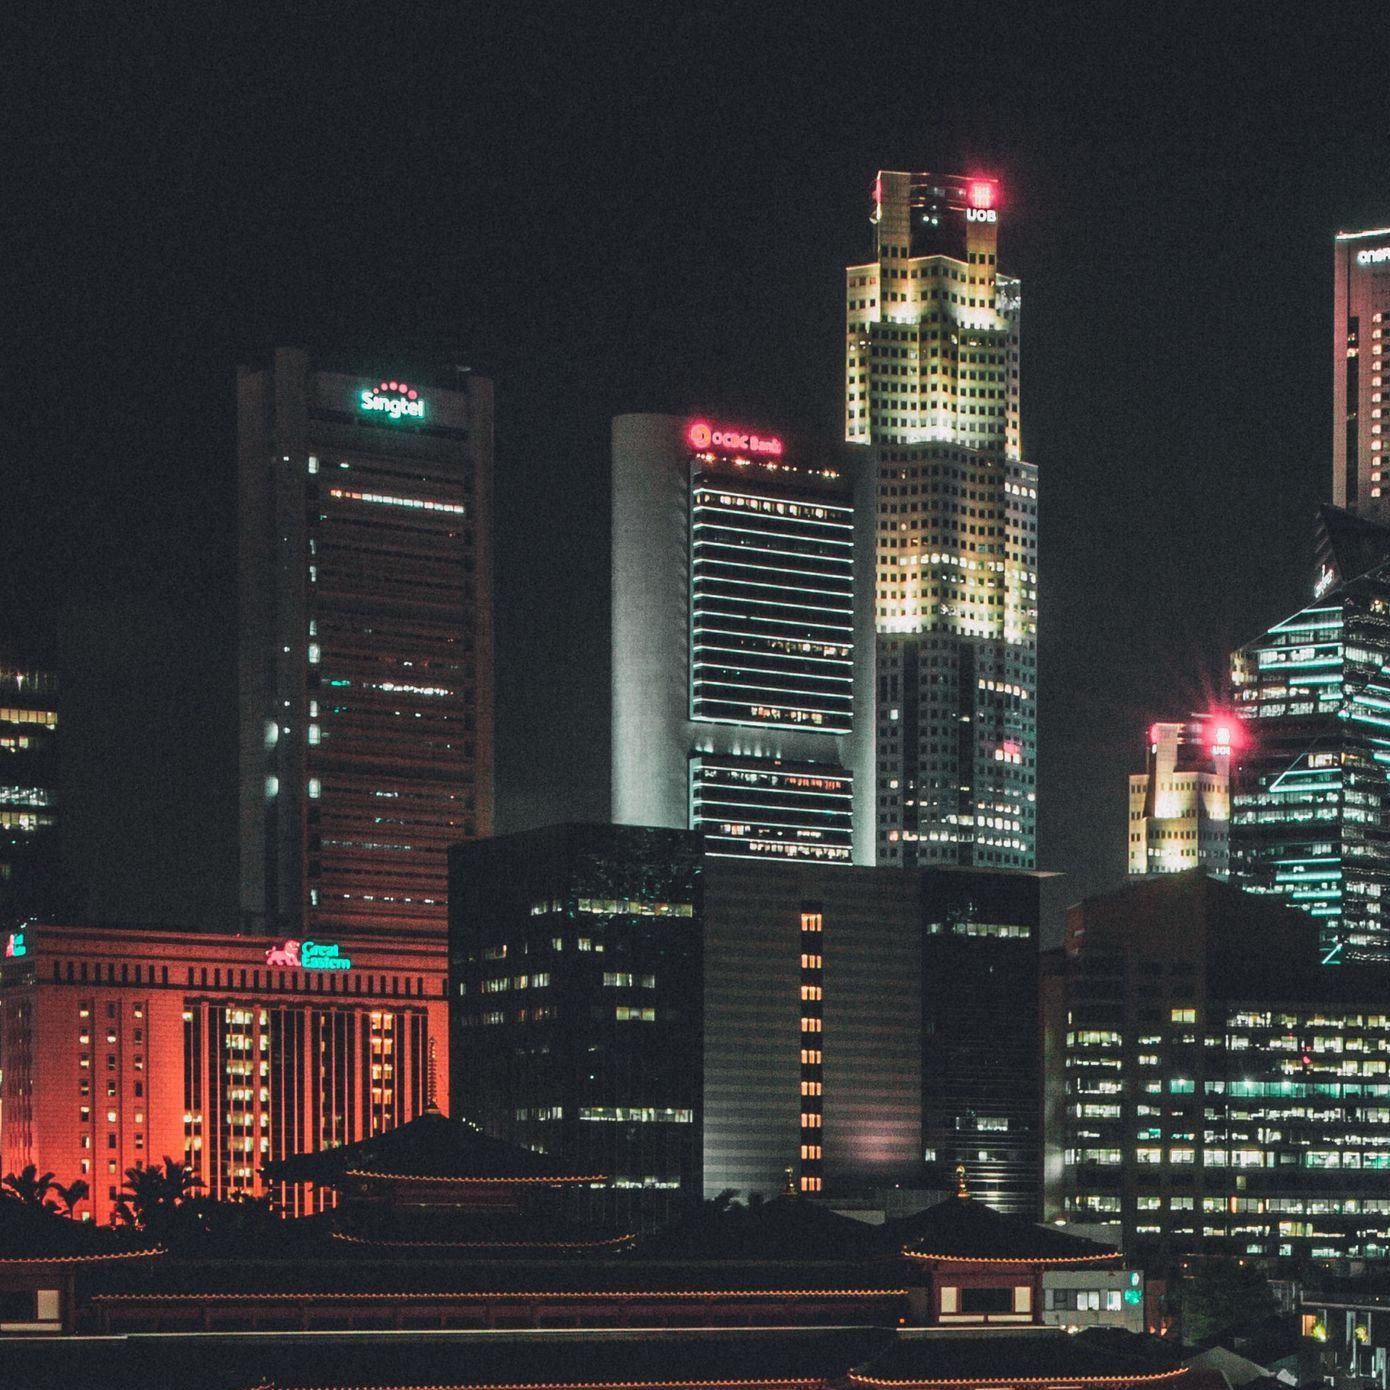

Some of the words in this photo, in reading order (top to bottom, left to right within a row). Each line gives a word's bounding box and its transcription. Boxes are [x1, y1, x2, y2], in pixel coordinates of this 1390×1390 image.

[966, 207, 997, 223] UOB
[361, 391, 425, 419] Singtel
[301, 941, 339, 958] Great
[301, 955, 351, 970] Eastern
